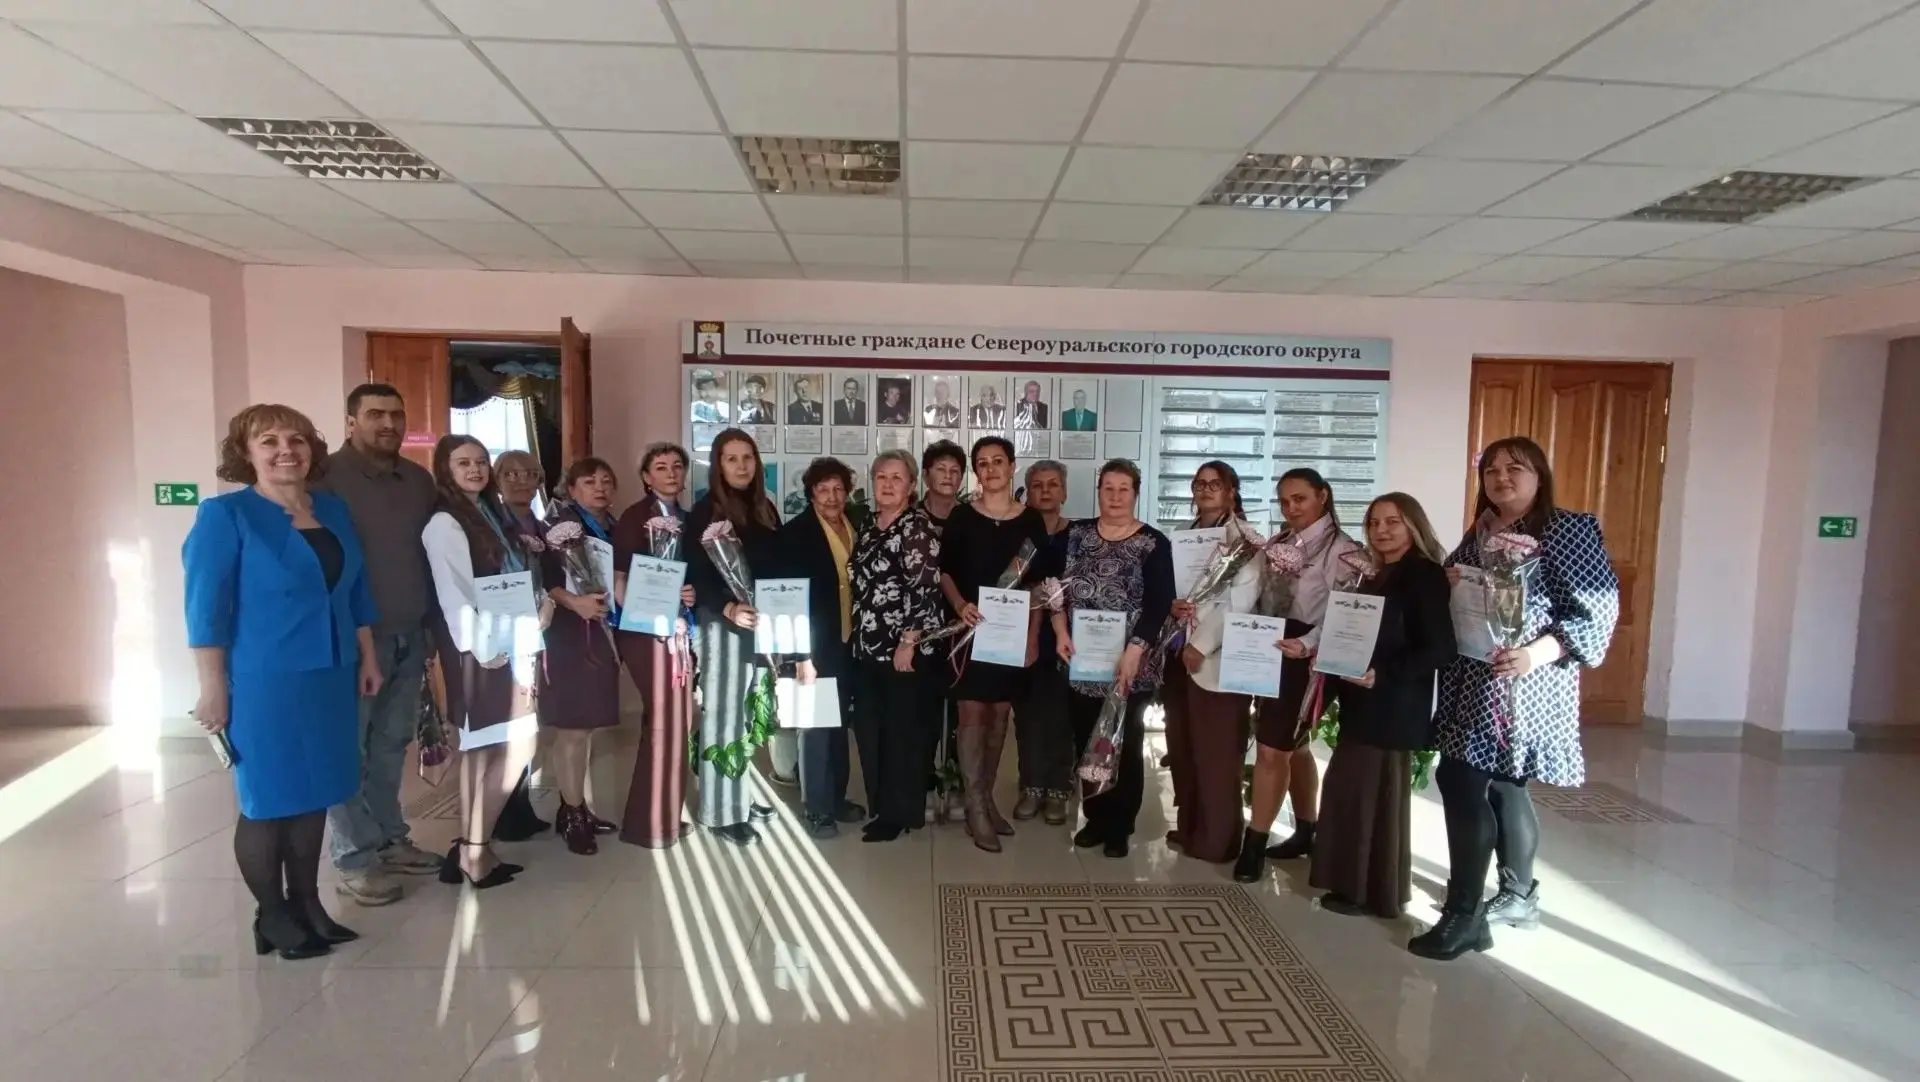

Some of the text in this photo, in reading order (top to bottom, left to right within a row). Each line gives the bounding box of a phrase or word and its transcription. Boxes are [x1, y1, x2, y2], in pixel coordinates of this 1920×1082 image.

[744, 328, 1361, 362] Почетные граждане Североуральского городского округа
